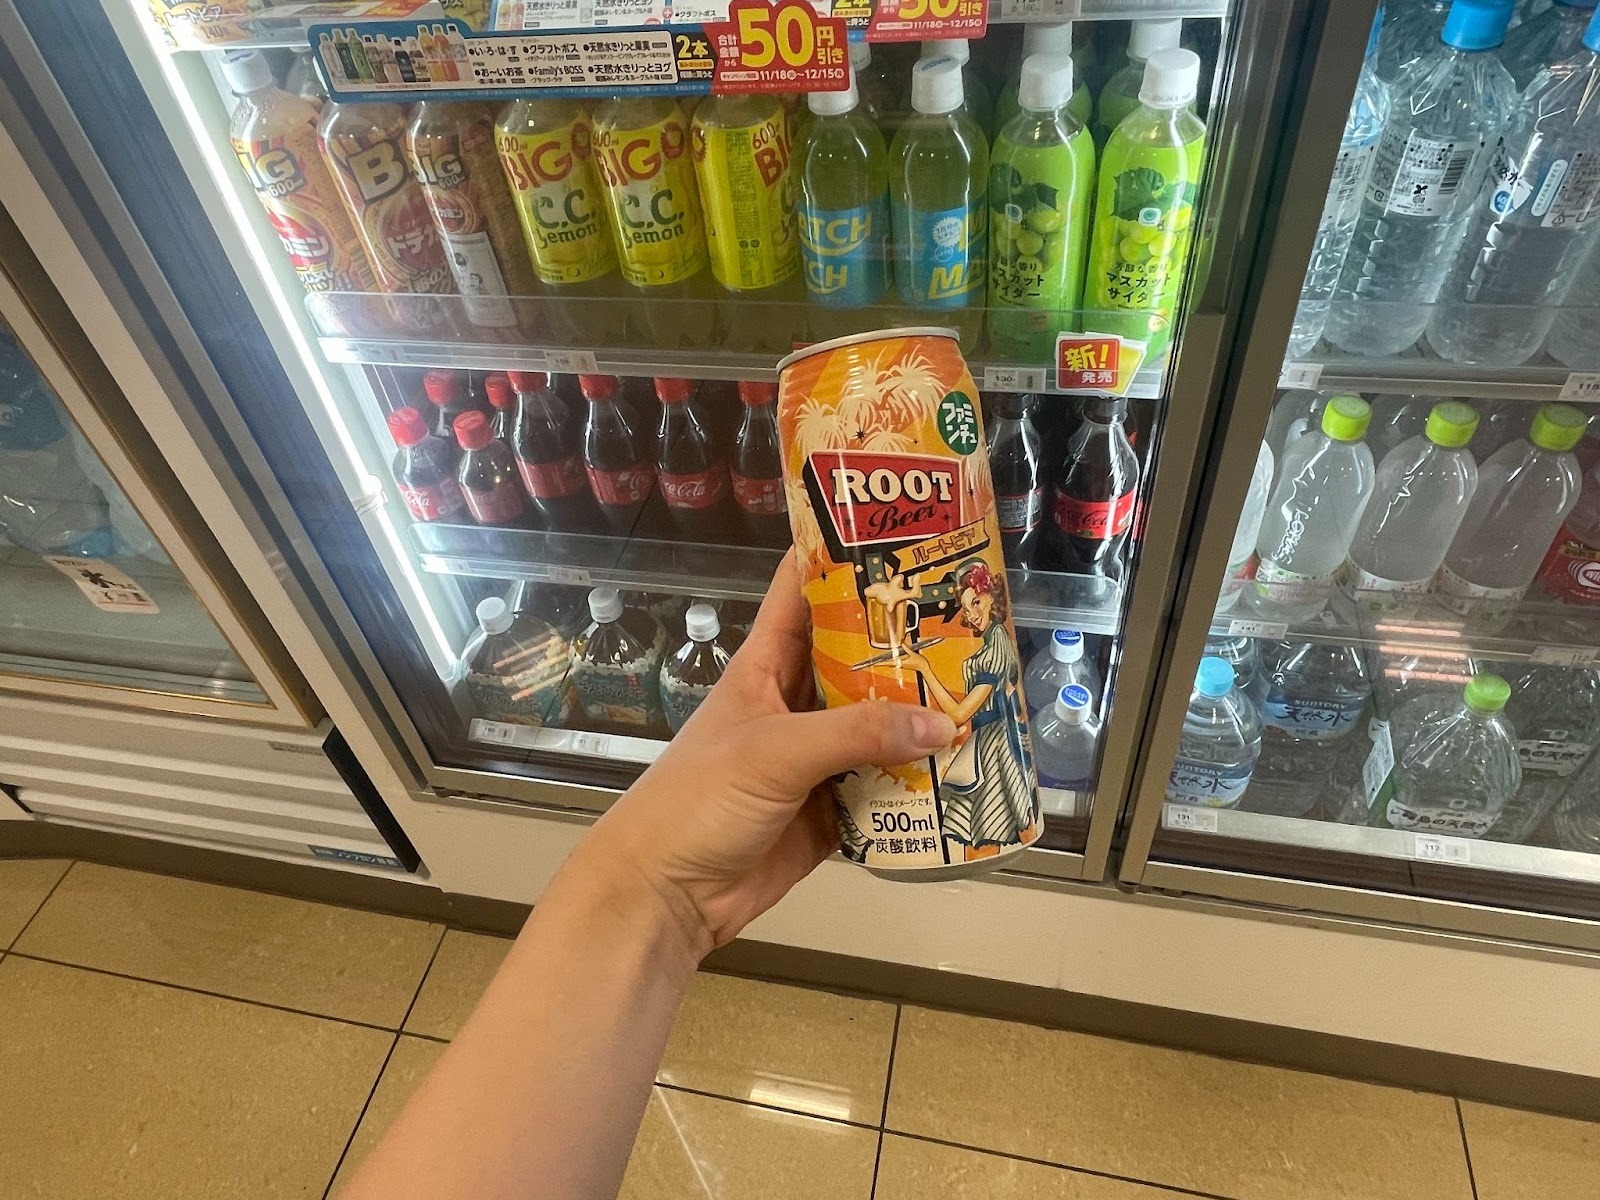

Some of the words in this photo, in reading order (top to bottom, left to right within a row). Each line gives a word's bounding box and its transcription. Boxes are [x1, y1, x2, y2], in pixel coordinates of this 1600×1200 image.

[676, 35, 708, 59] 2本
[737, 5, 815, 68] 50
[816, 26, 835, 47] 円
[529, 43, 579, 54] クラフトボス
[817, 47, 844, 65] 引き
[564, 65, 584, 75] BOSS
[501, 141, 573, 191] BIG
[593, 138, 663, 188] BIG
[532, 189, 597, 229] C.C.
[619, 188, 685, 229] C.C.
[1106, 271, 1171, 288] マスカット
[1107, 286, 1166, 304] サイダー
[1064, 343, 1110, 373] 新!
[1081, 371, 1113, 384] 発売
[831, 467, 954, 505] ROOT
[867, 504, 938, 538] Beer
[912, 528, 977, 565] ルートビア
[1294, 699, 1348, 710] SUNTORY
[1275, 705, 1352, 728] 天然水
[871, 811, 935, 833] 500ml
[874, 835, 938, 854] 炭酸飲料
